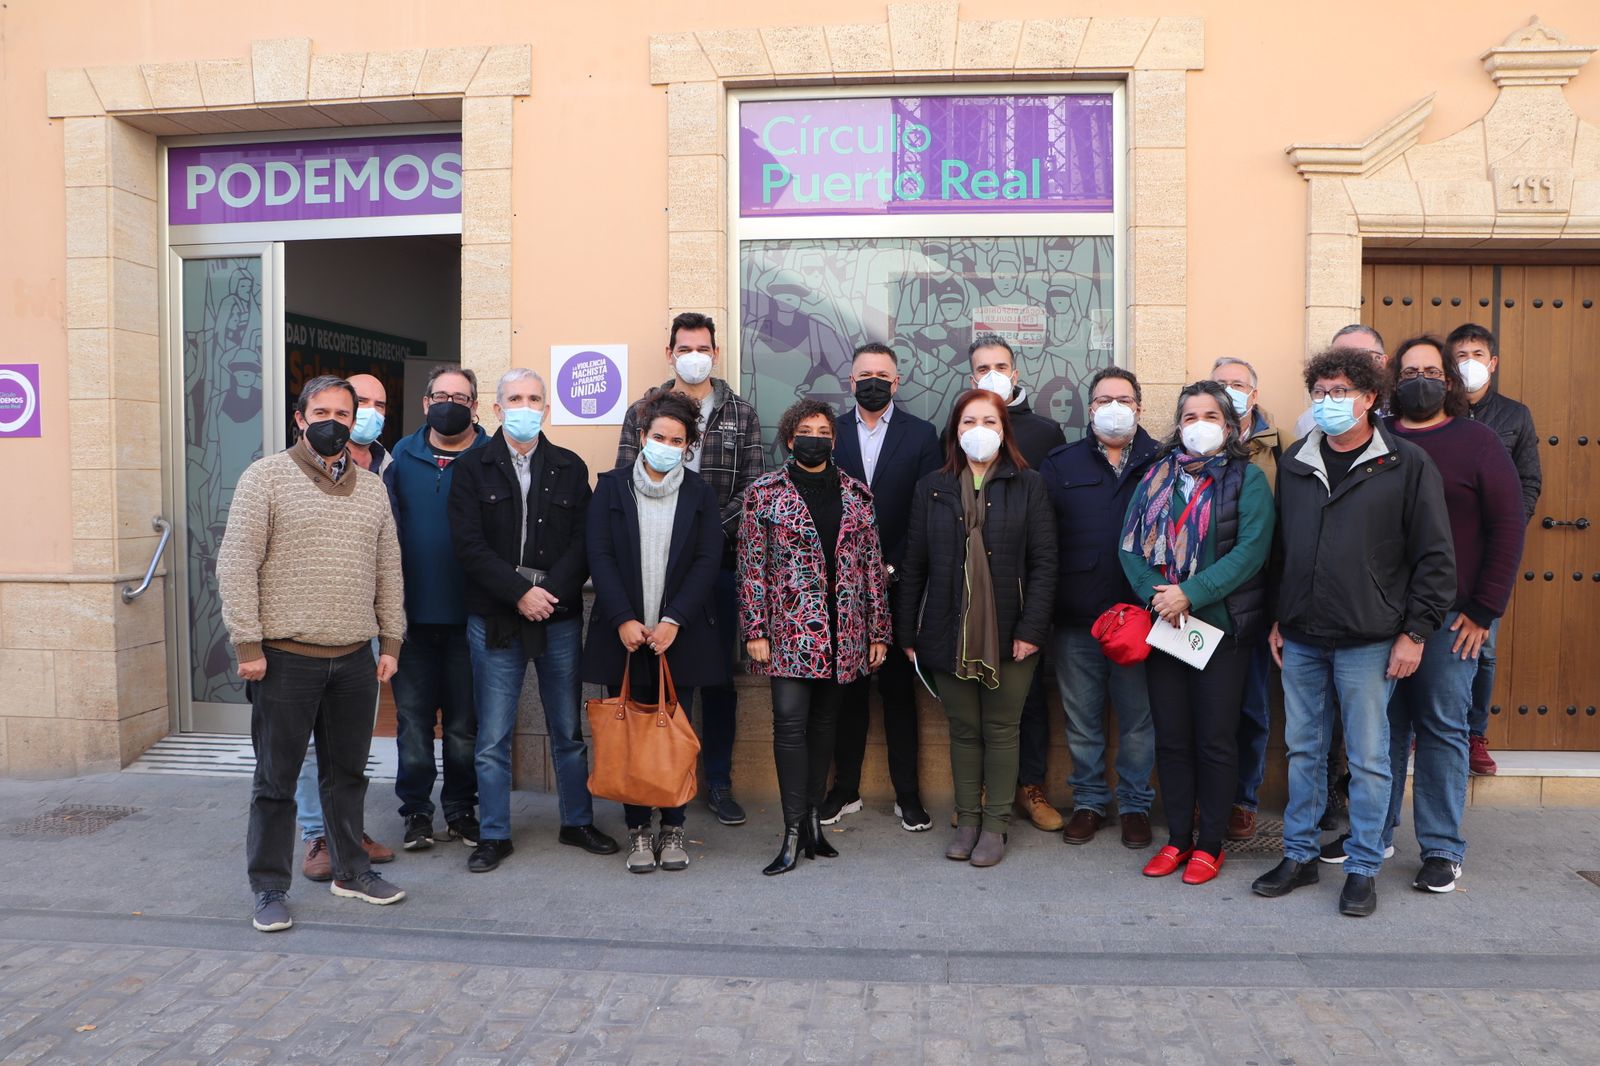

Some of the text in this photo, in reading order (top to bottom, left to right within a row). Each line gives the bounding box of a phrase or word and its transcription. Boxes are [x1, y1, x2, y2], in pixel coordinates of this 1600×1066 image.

[762, 113, 932, 157] Círculo
[186, 152, 462, 210] PODEMOS
[762, 158, 1041, 204] Puerto Real
[309, 327, 317, 349] Y
[318, 329, 361, 356] RECORTES
[361, 339, 372, 357] DE
[571, 380, 607, 399] UNIDAS
[572, 365, 608, 380] MACHISTA
